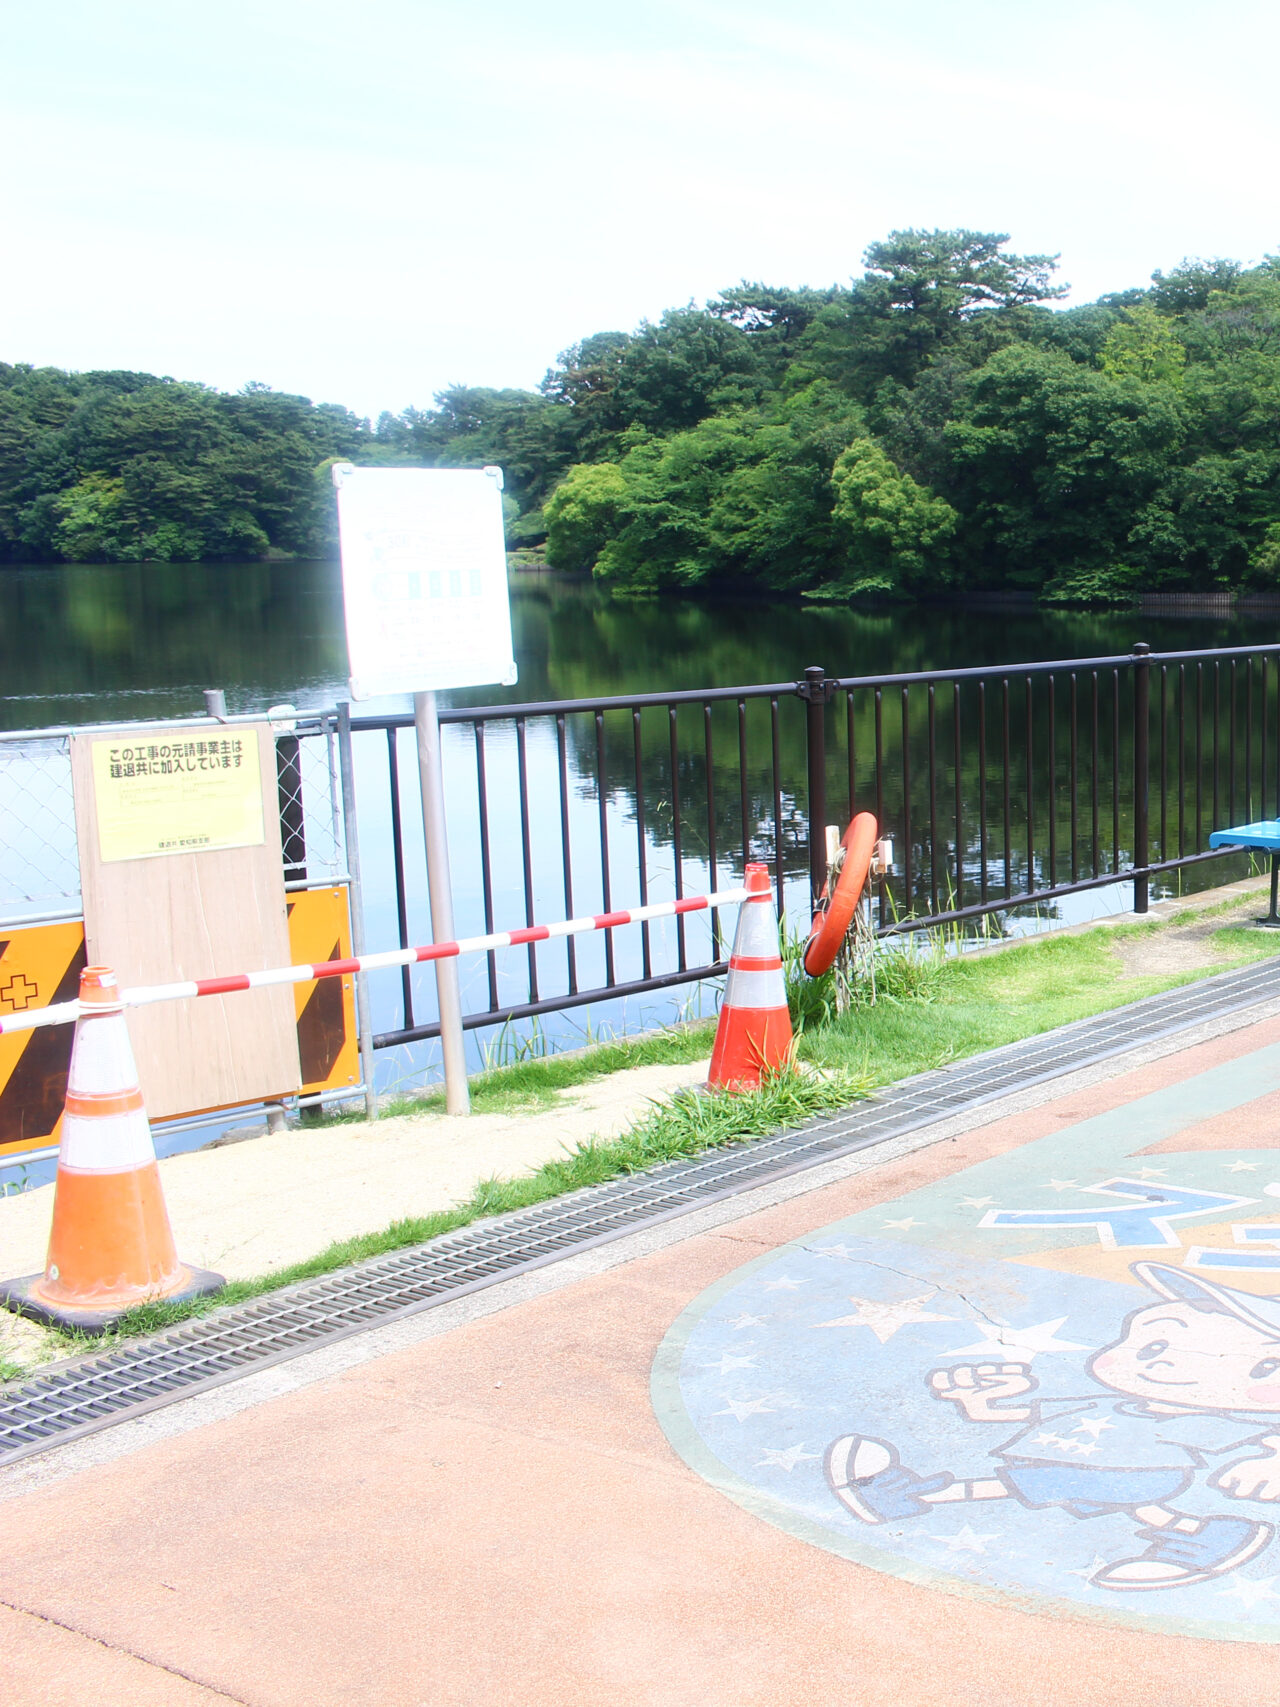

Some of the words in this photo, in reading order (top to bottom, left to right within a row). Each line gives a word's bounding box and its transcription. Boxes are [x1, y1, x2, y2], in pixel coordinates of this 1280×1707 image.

[109, 740, 243, 763] この工事の元請事業主は
[109, 753, 243, 779] 建退共に加入しています
